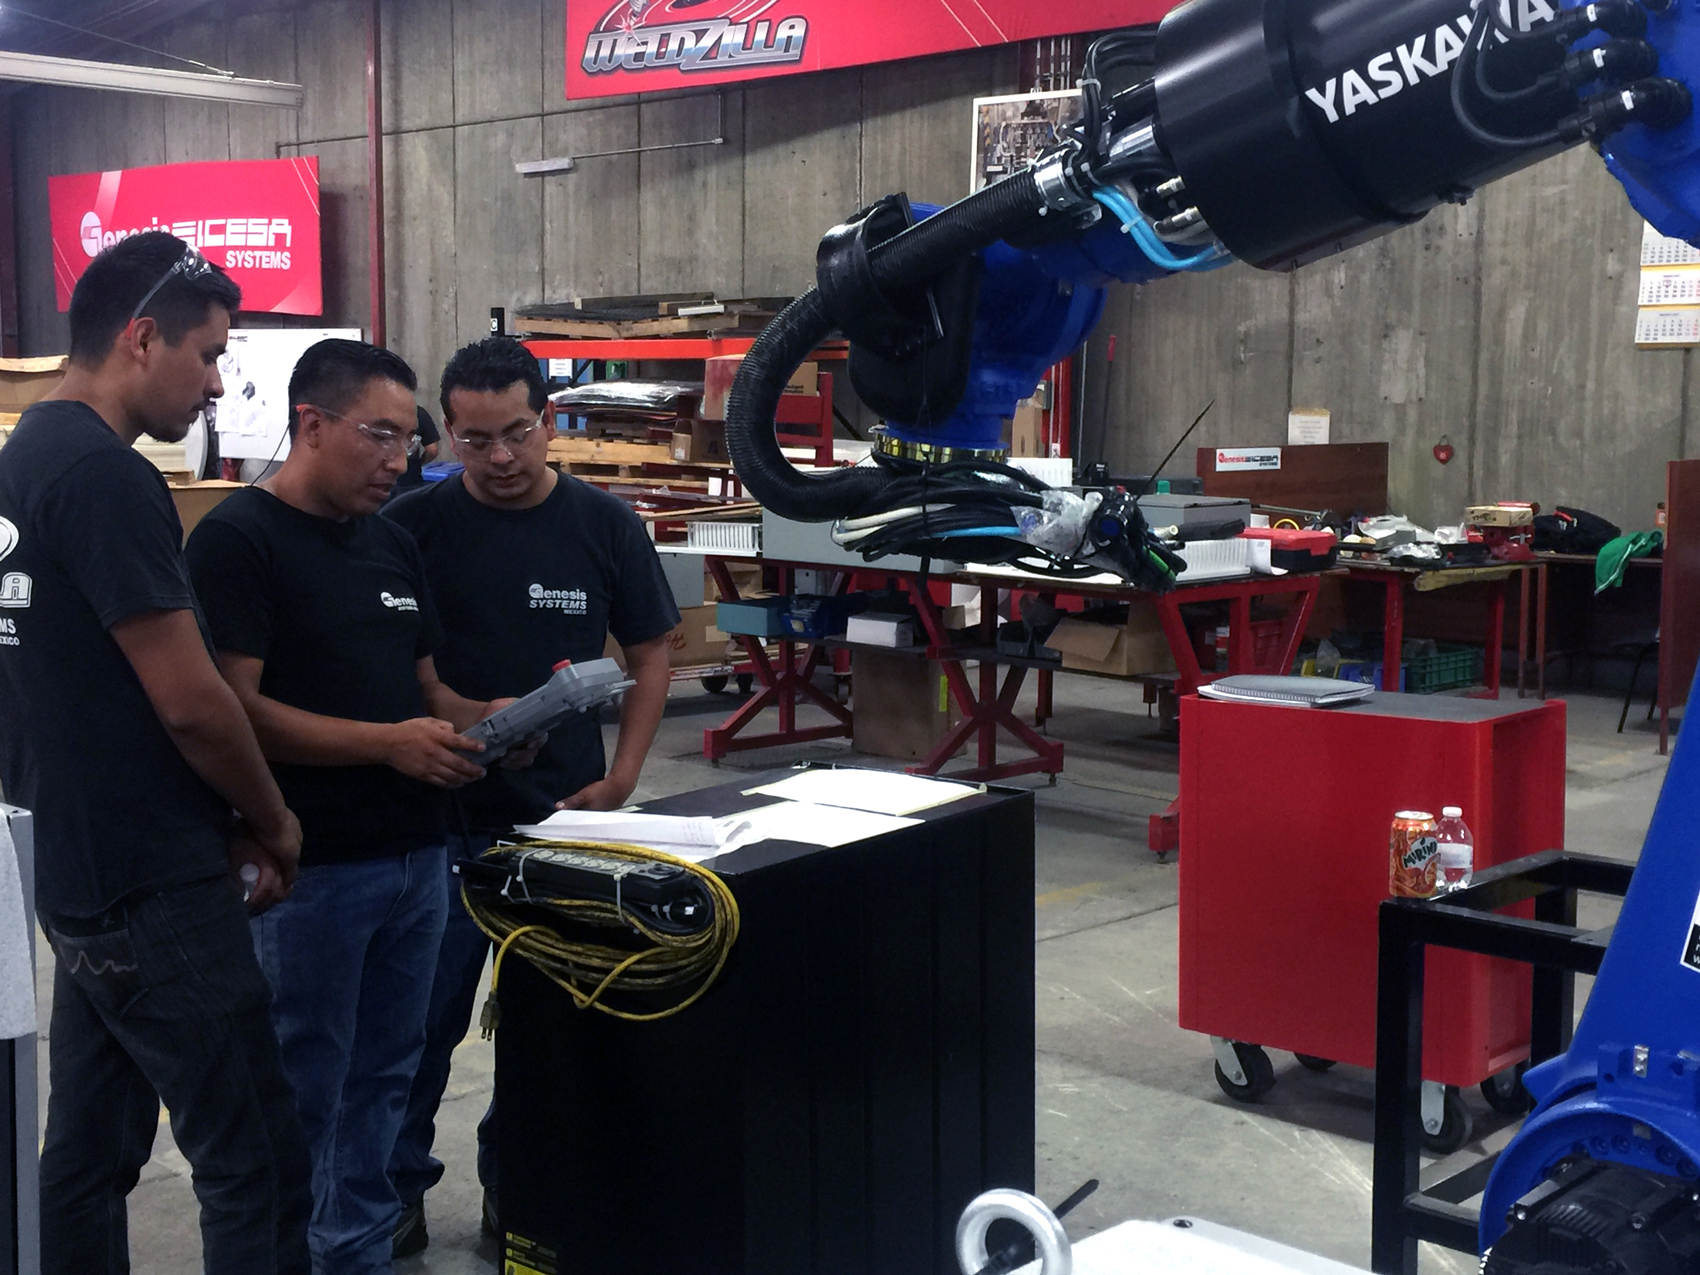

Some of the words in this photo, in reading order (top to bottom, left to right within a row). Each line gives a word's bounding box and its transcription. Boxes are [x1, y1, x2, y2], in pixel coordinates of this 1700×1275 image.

[582, 16, 807, 73] WELDZILLA
[1305, 0, 1555, 123] YASKAA
[225, 250, 291, 270] SYSTEMS
[528, 583, 587, 600] Genesis
[529, 599, 587, 610] SYSTEMS
